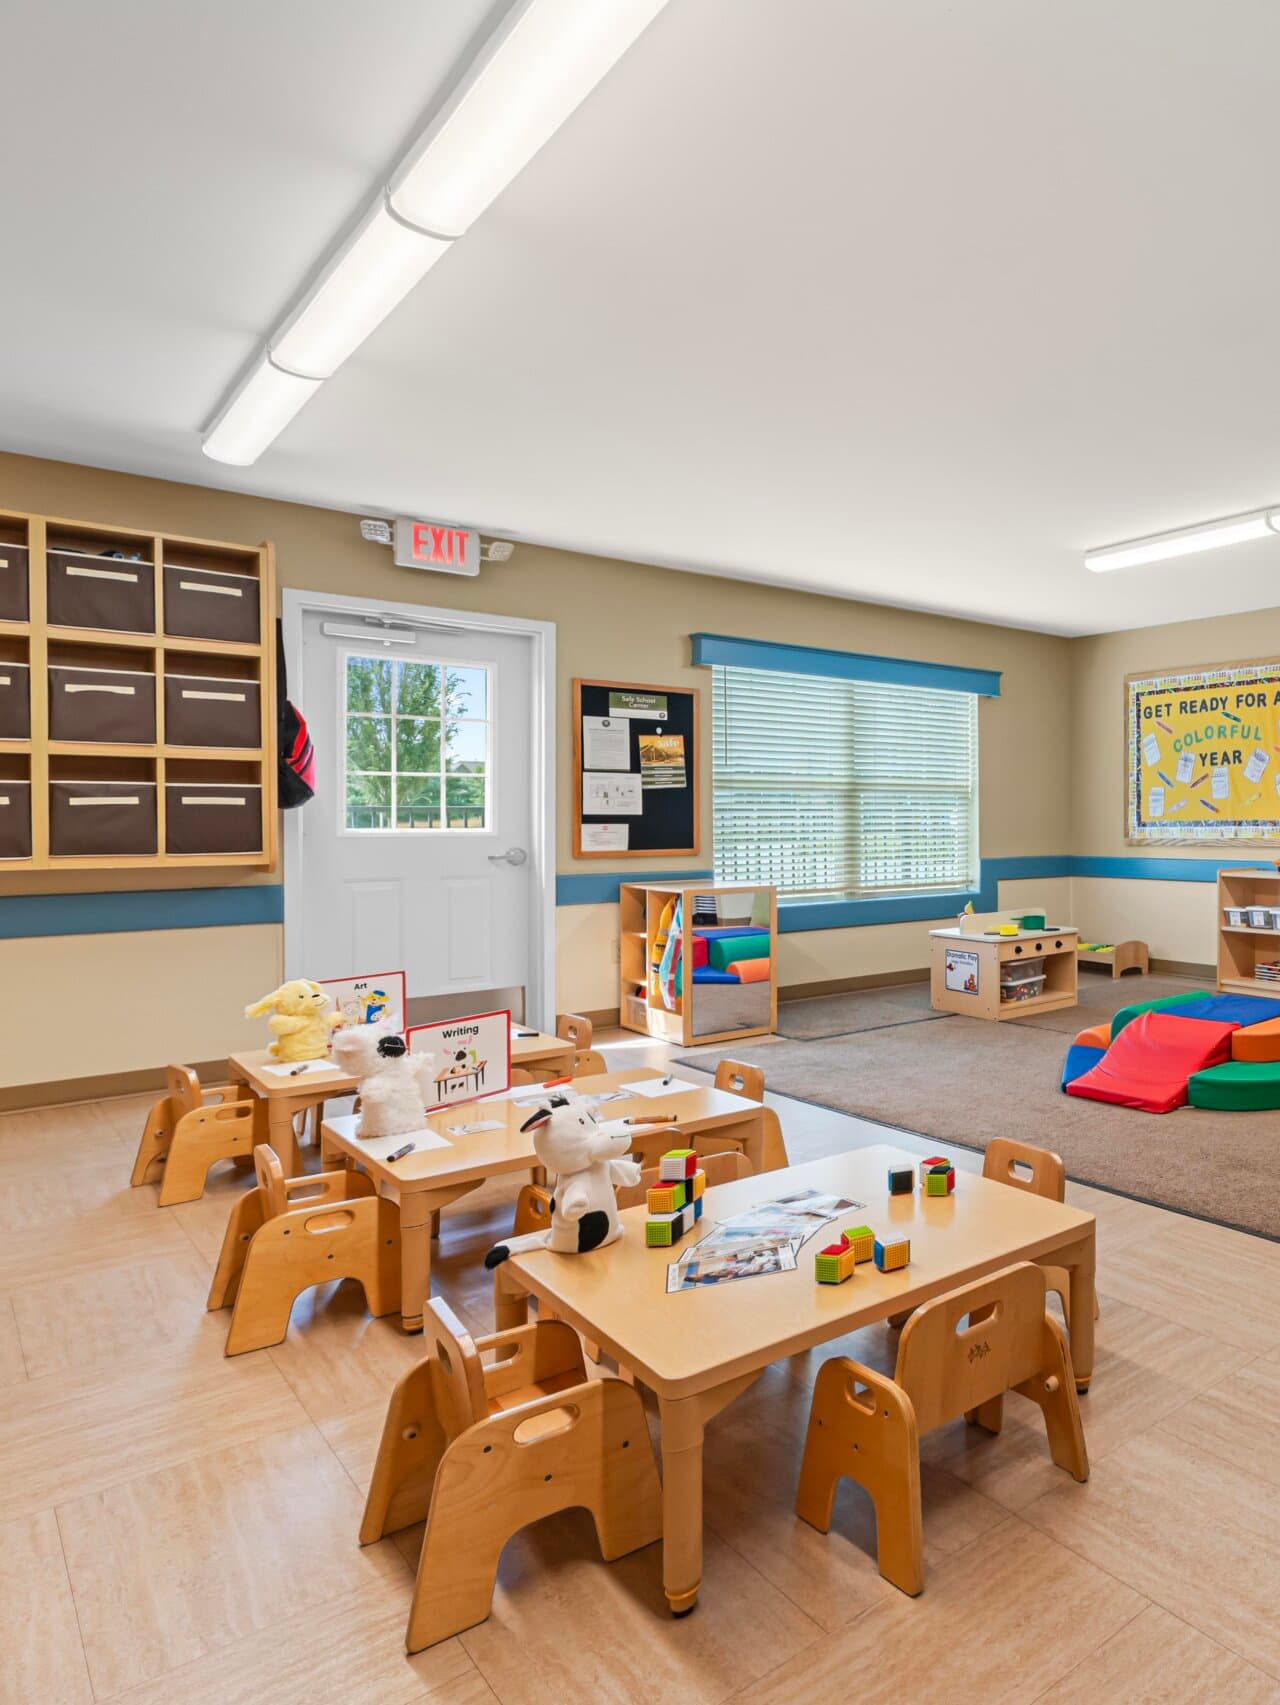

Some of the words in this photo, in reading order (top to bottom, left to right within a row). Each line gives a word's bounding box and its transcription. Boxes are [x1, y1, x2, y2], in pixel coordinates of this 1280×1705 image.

[411, 521, 470, 567] EXIT
[1143, 703, 1173, 719] GET
[1179, 696, 1229, 715] READY
[1236, 692, 1267, 708] FOR
[1173, 725, 1262, 753] COLORFUL
[1199, 749, 1242, 767] YEAR
[353, 982, 367, 990] Art
[442, 1024, 479, 1039] Writing
